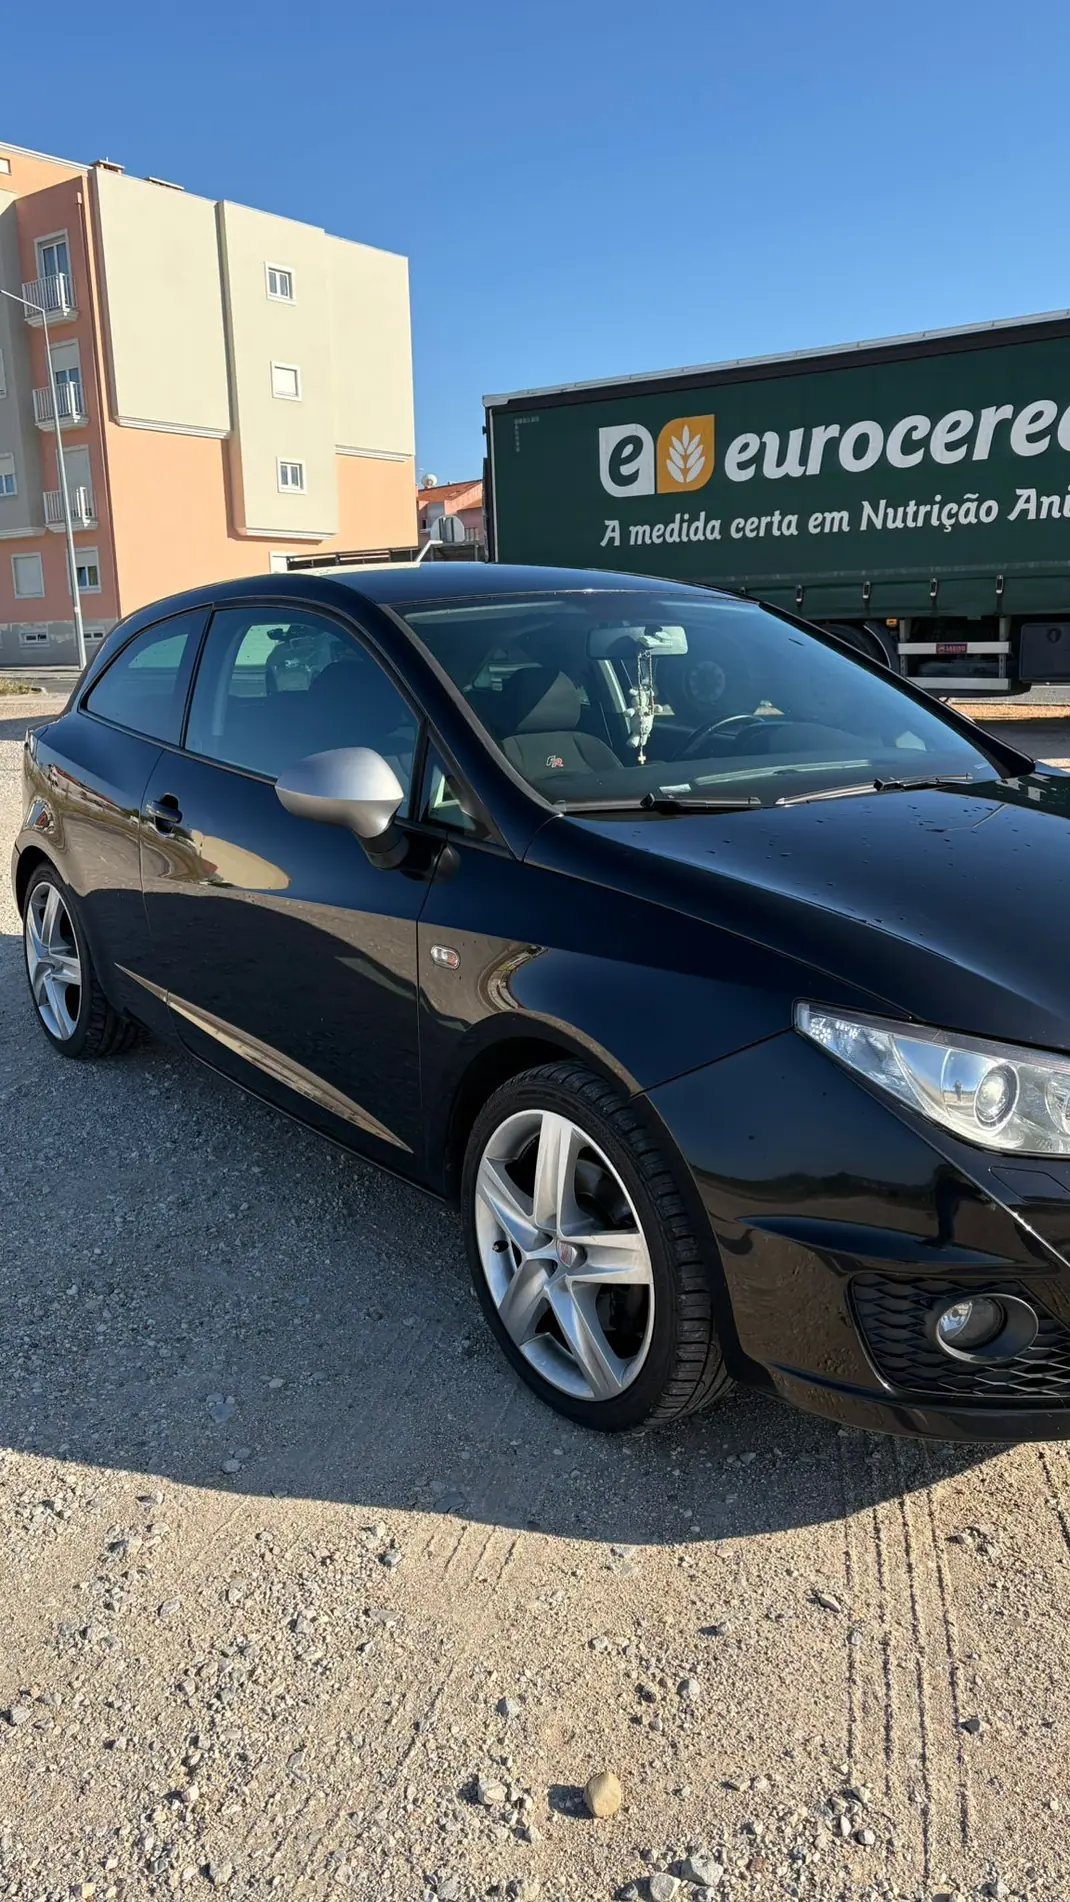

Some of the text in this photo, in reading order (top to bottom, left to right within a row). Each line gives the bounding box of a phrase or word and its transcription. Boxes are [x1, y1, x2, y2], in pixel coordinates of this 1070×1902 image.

[600, 519, 621, 546] A
[629, 511, 721, 545] medida
[730, 510, 799, 539] certa
[808, 509, 850, 534] em
[860, 493, 999, 532] Nutrição
